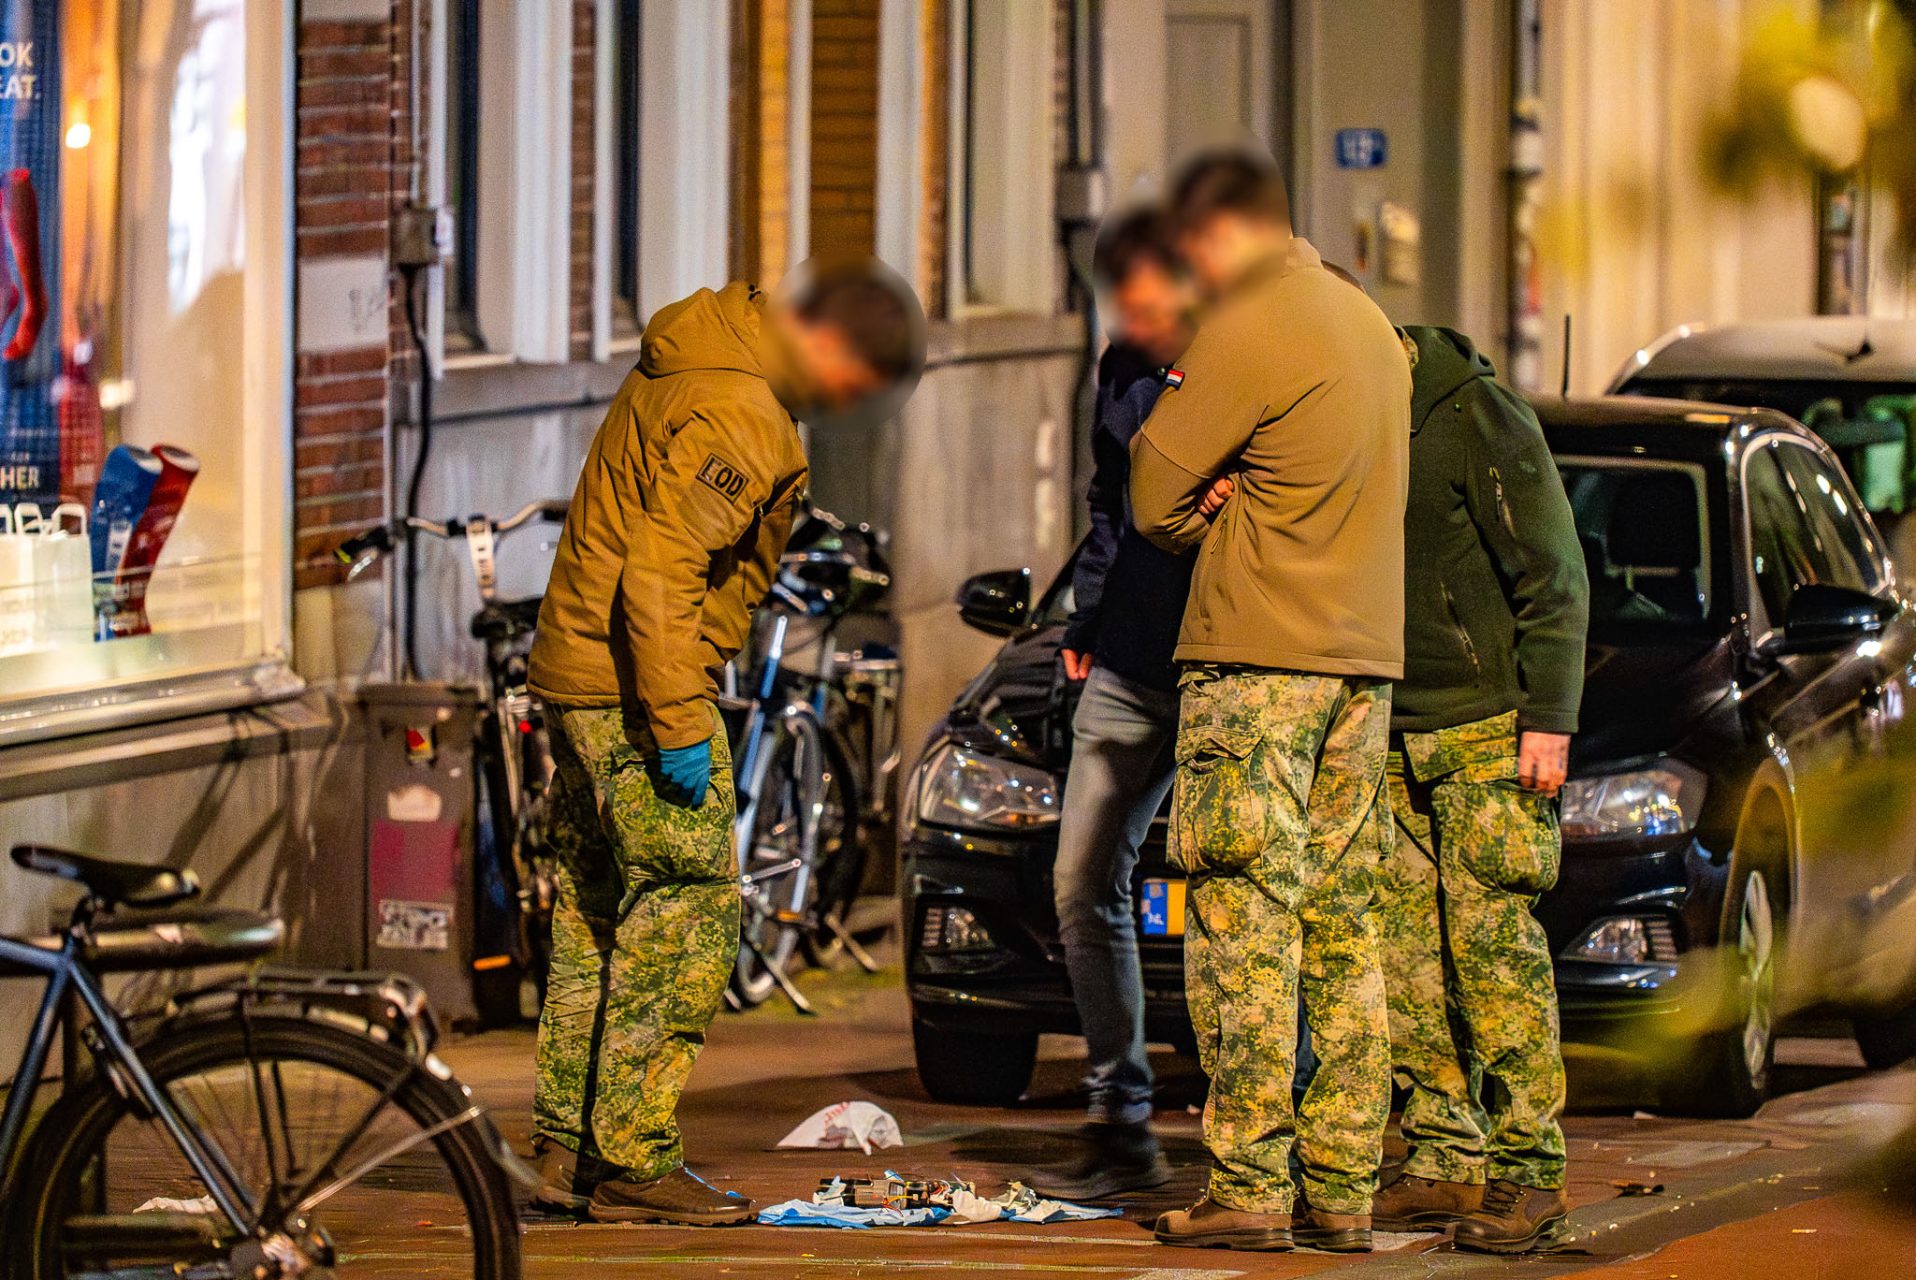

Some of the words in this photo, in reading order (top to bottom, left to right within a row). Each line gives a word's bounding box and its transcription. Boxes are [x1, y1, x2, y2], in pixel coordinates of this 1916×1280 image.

[0, 74, 42, 100] AT.
[0, 466, 40, 490] HER
[700, 457, 744, 497] EOD
